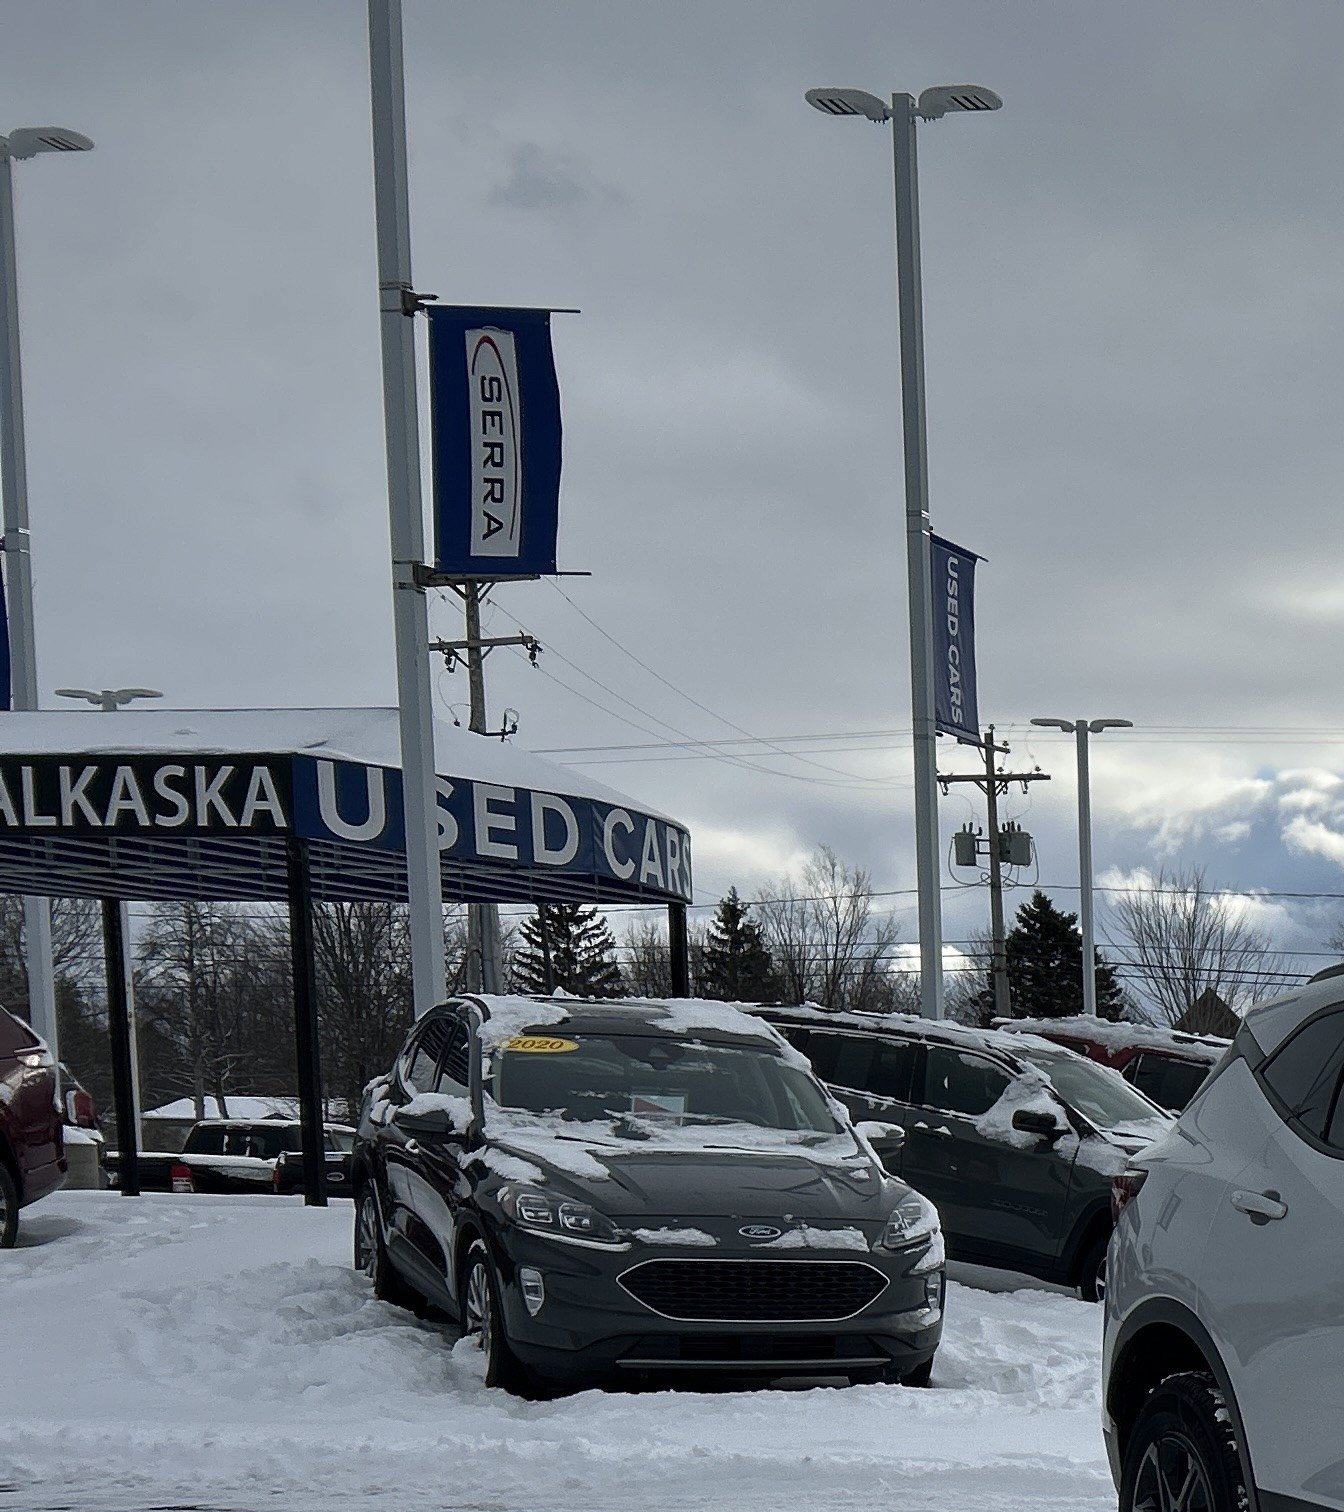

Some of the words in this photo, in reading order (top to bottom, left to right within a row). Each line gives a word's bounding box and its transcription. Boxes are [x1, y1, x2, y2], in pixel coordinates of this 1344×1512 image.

[480, 374, 505, 541] SERRA
[946, 556, 959, 637] USED
[948, 644, 963, 725] CARS
[603, 807, 692, 899] CARS
[507, 1039, 565, 1050] 2020
